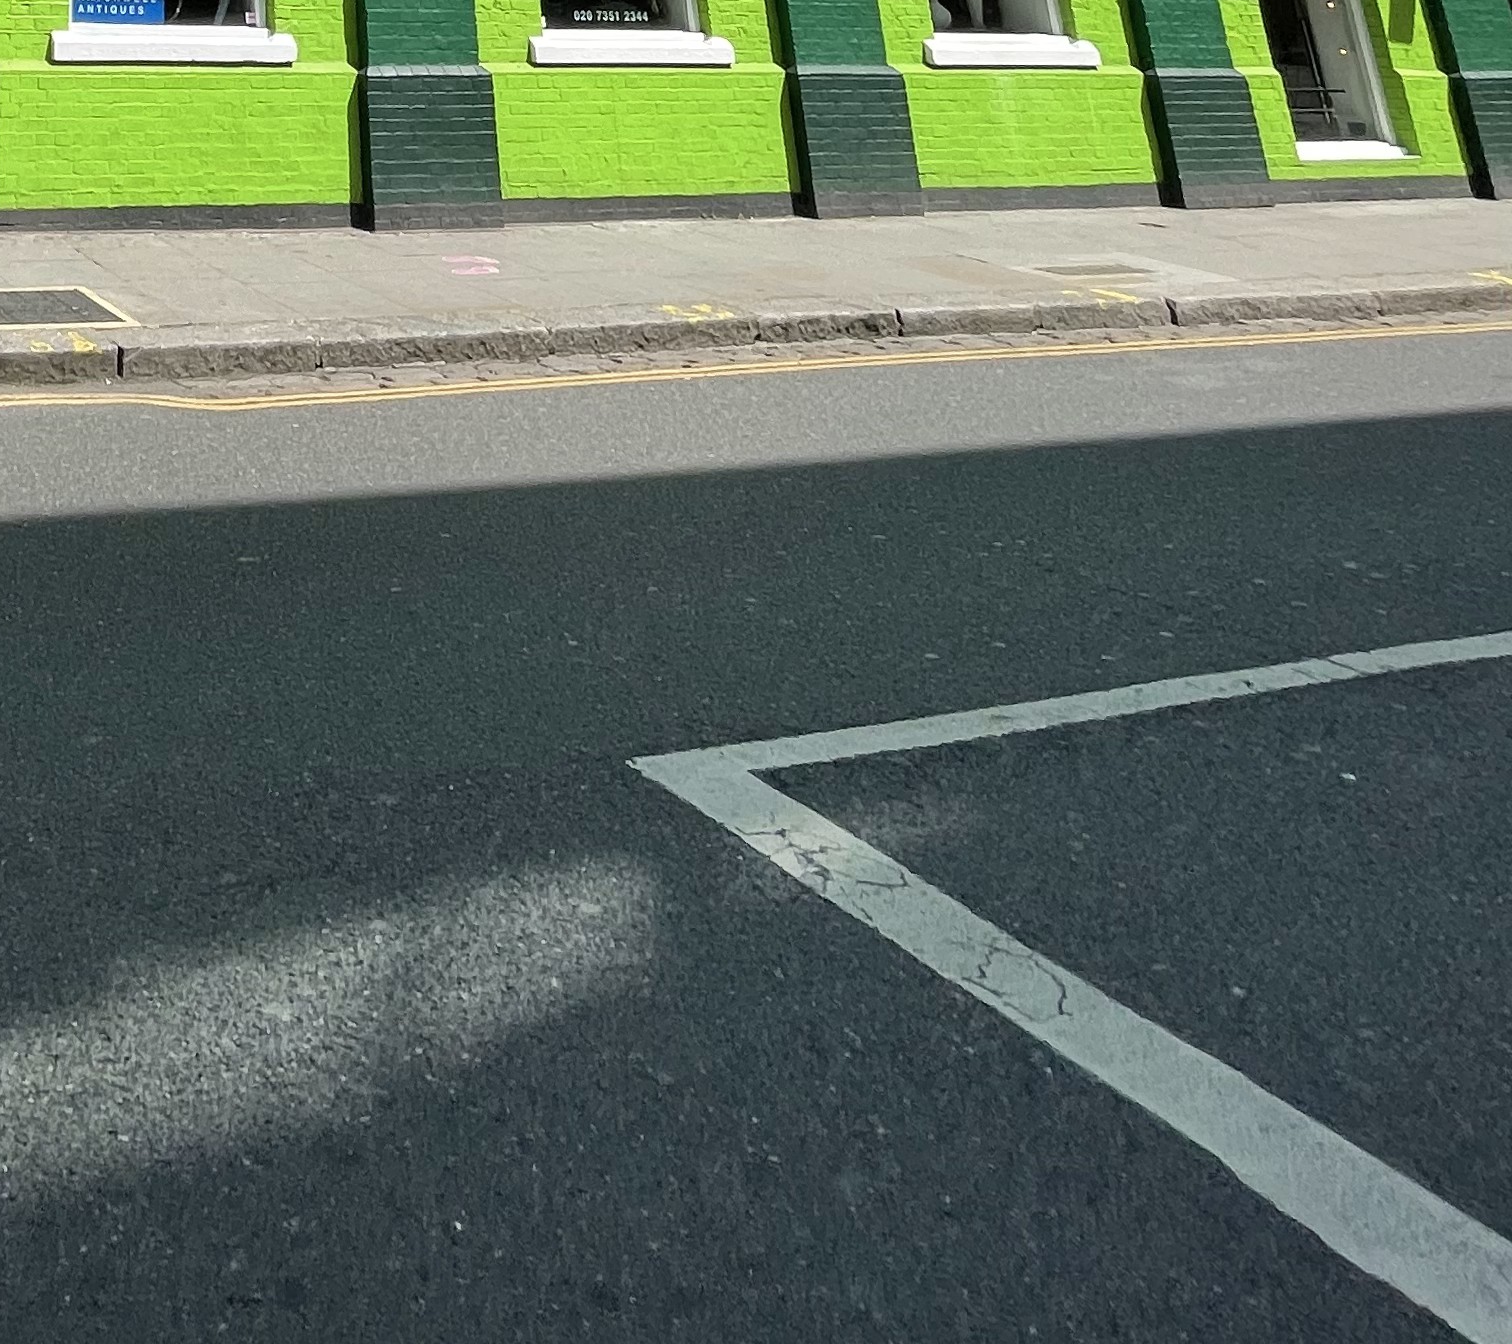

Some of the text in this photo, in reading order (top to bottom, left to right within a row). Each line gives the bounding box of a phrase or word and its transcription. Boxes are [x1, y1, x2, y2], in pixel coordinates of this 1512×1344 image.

[77, 3, 145, 15] ANTIQUES
[573, 9, 649, 22] 020 7351 2344
